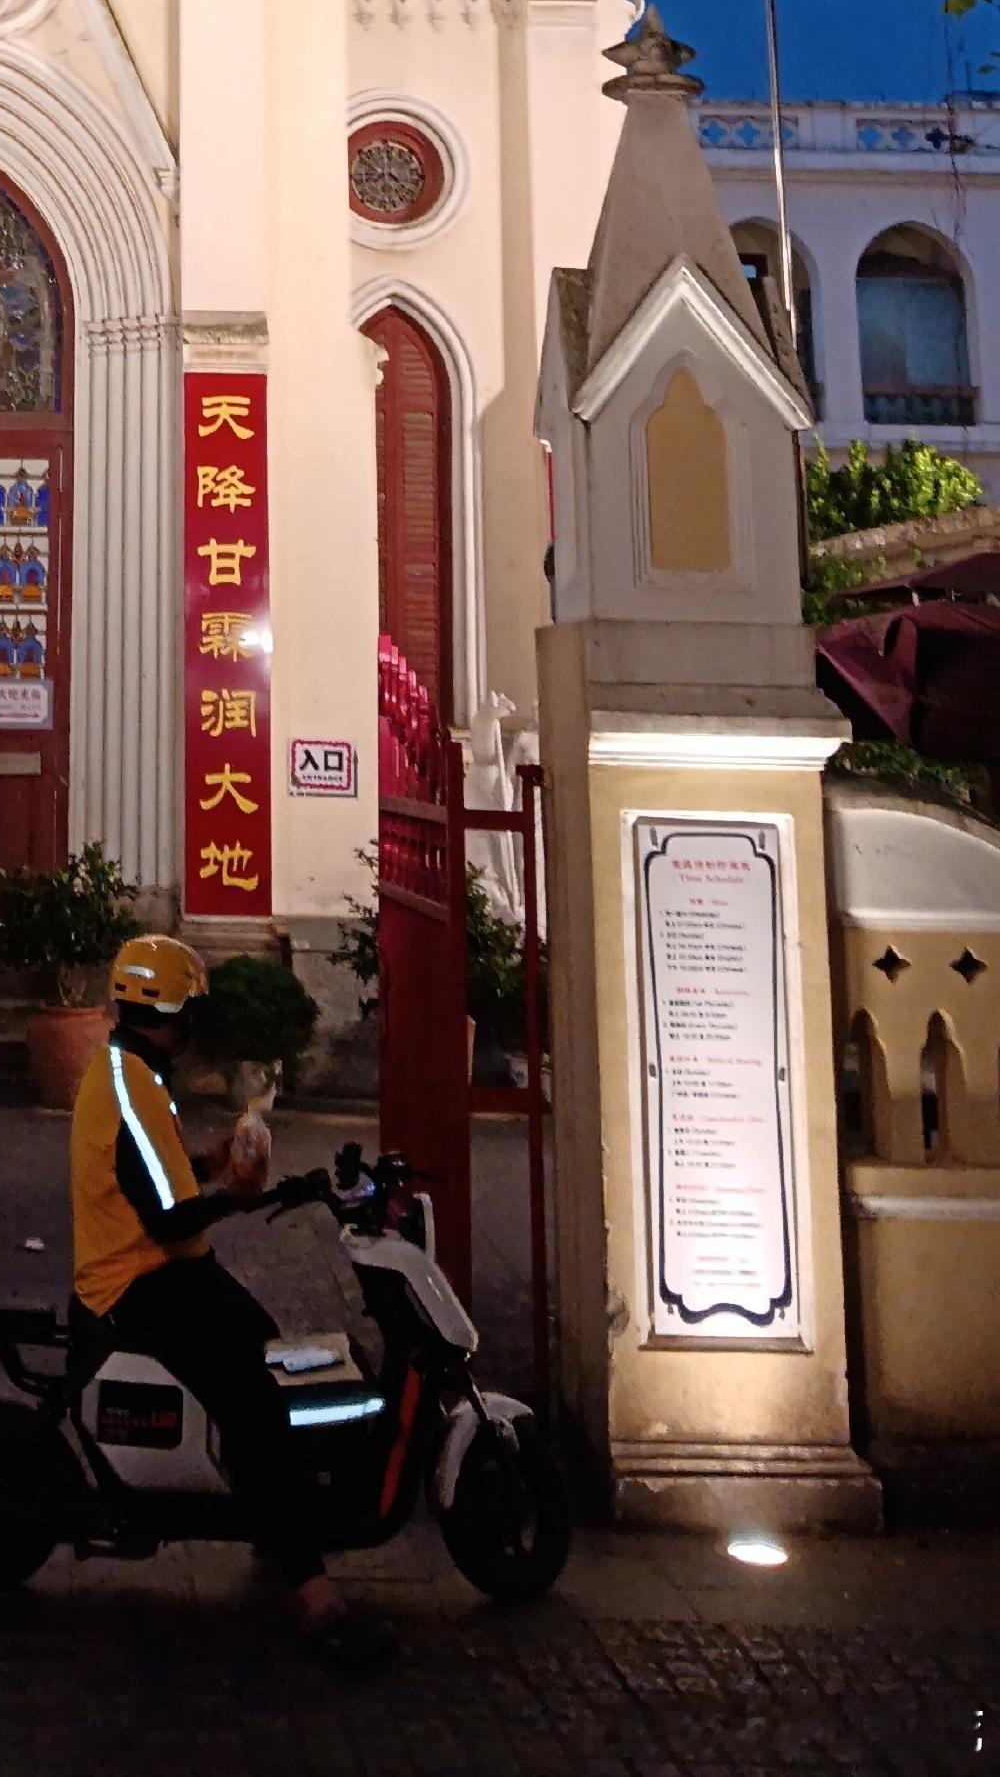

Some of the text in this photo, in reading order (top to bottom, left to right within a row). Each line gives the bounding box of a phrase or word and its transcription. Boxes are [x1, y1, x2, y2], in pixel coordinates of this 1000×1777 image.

[197, 394, 259, 891] 天降甘霖润大地
[299, 749, 344, 771] 入口
